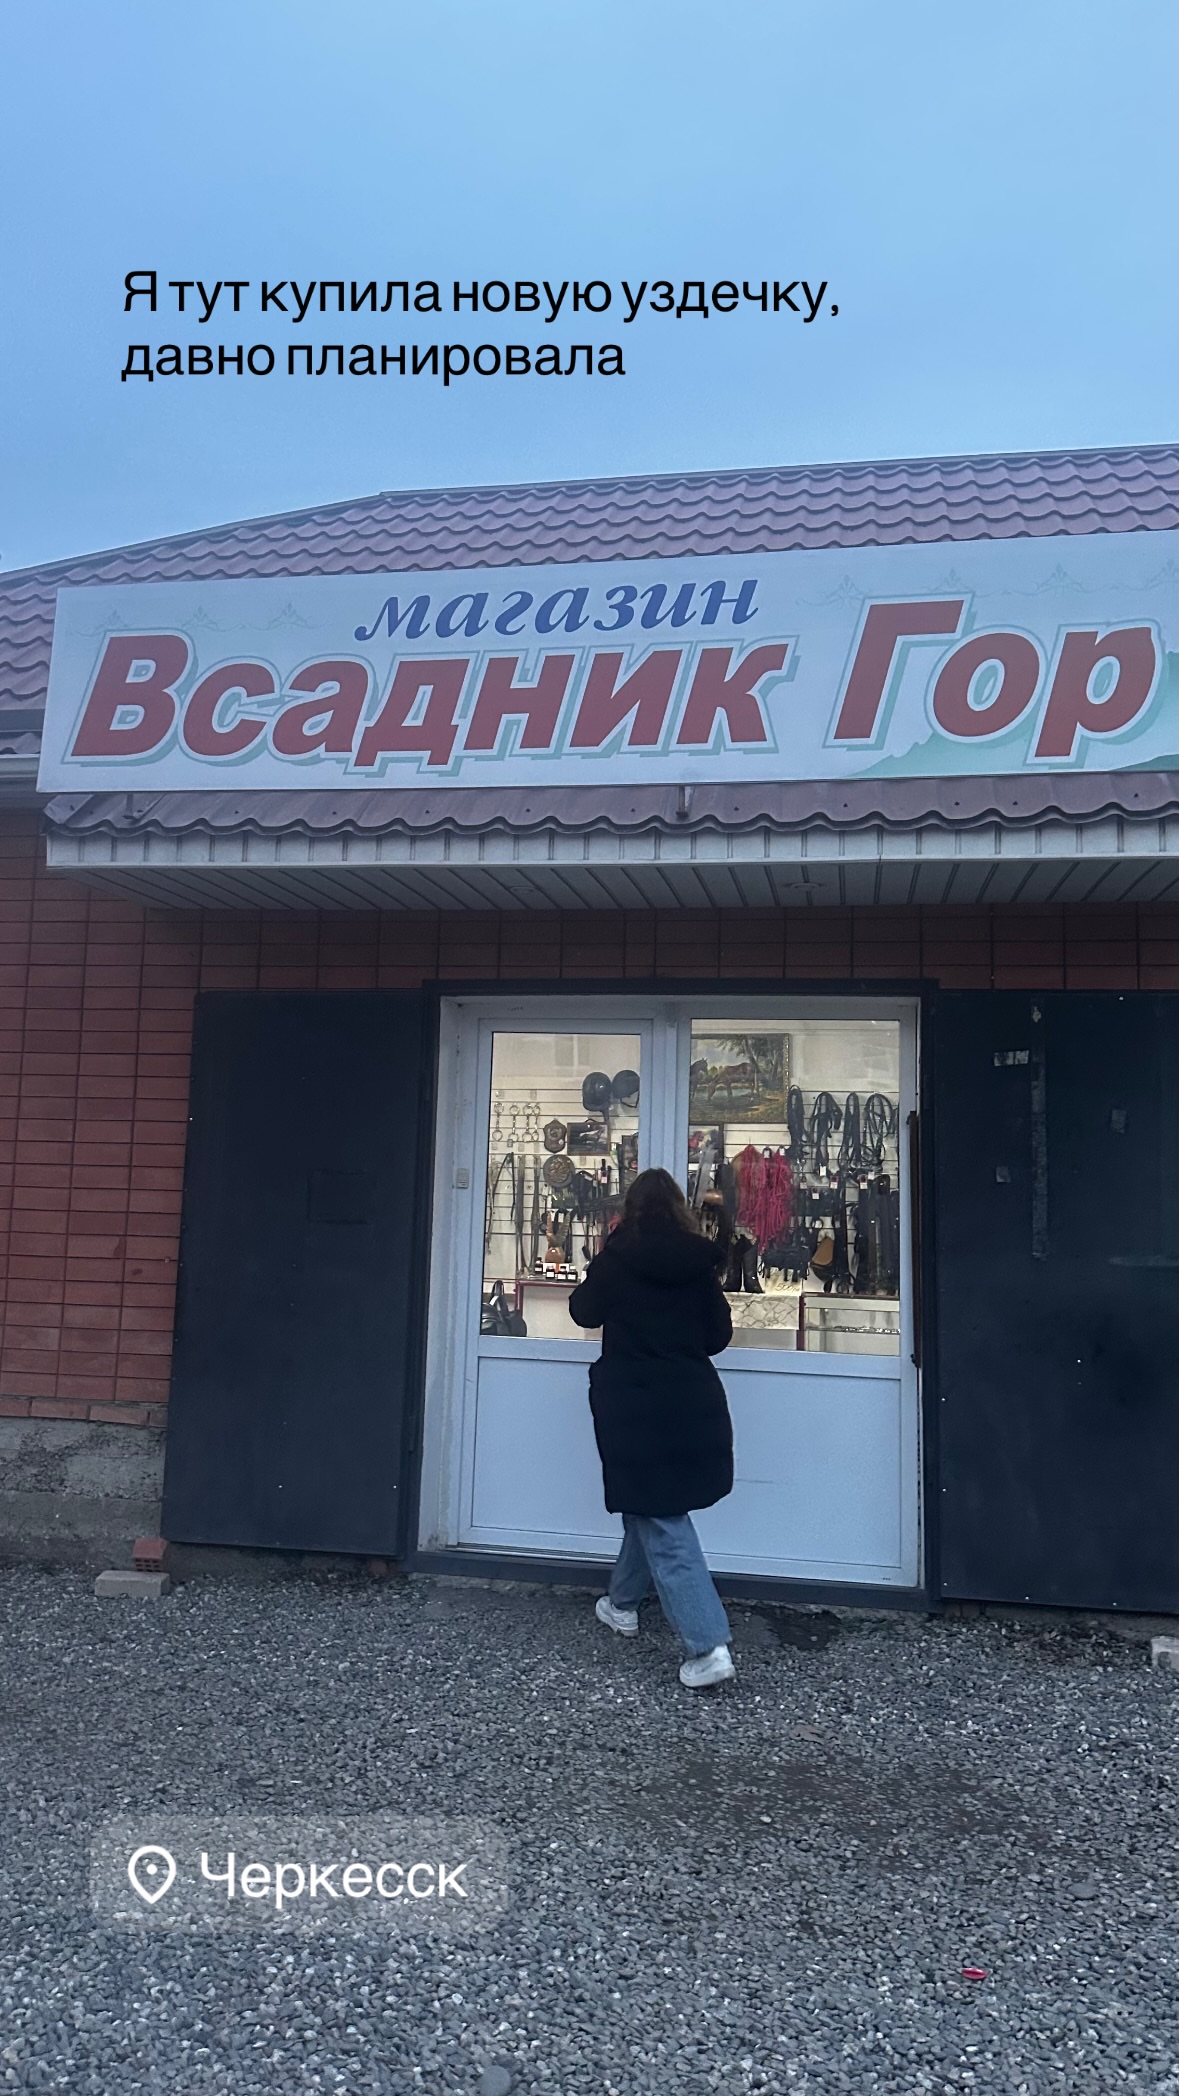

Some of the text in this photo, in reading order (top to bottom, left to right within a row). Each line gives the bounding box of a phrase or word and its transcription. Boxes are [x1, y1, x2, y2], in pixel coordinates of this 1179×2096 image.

[354, 579, 759, 641] магазин
[68, 598, 1159, 769] Всадник Гор
